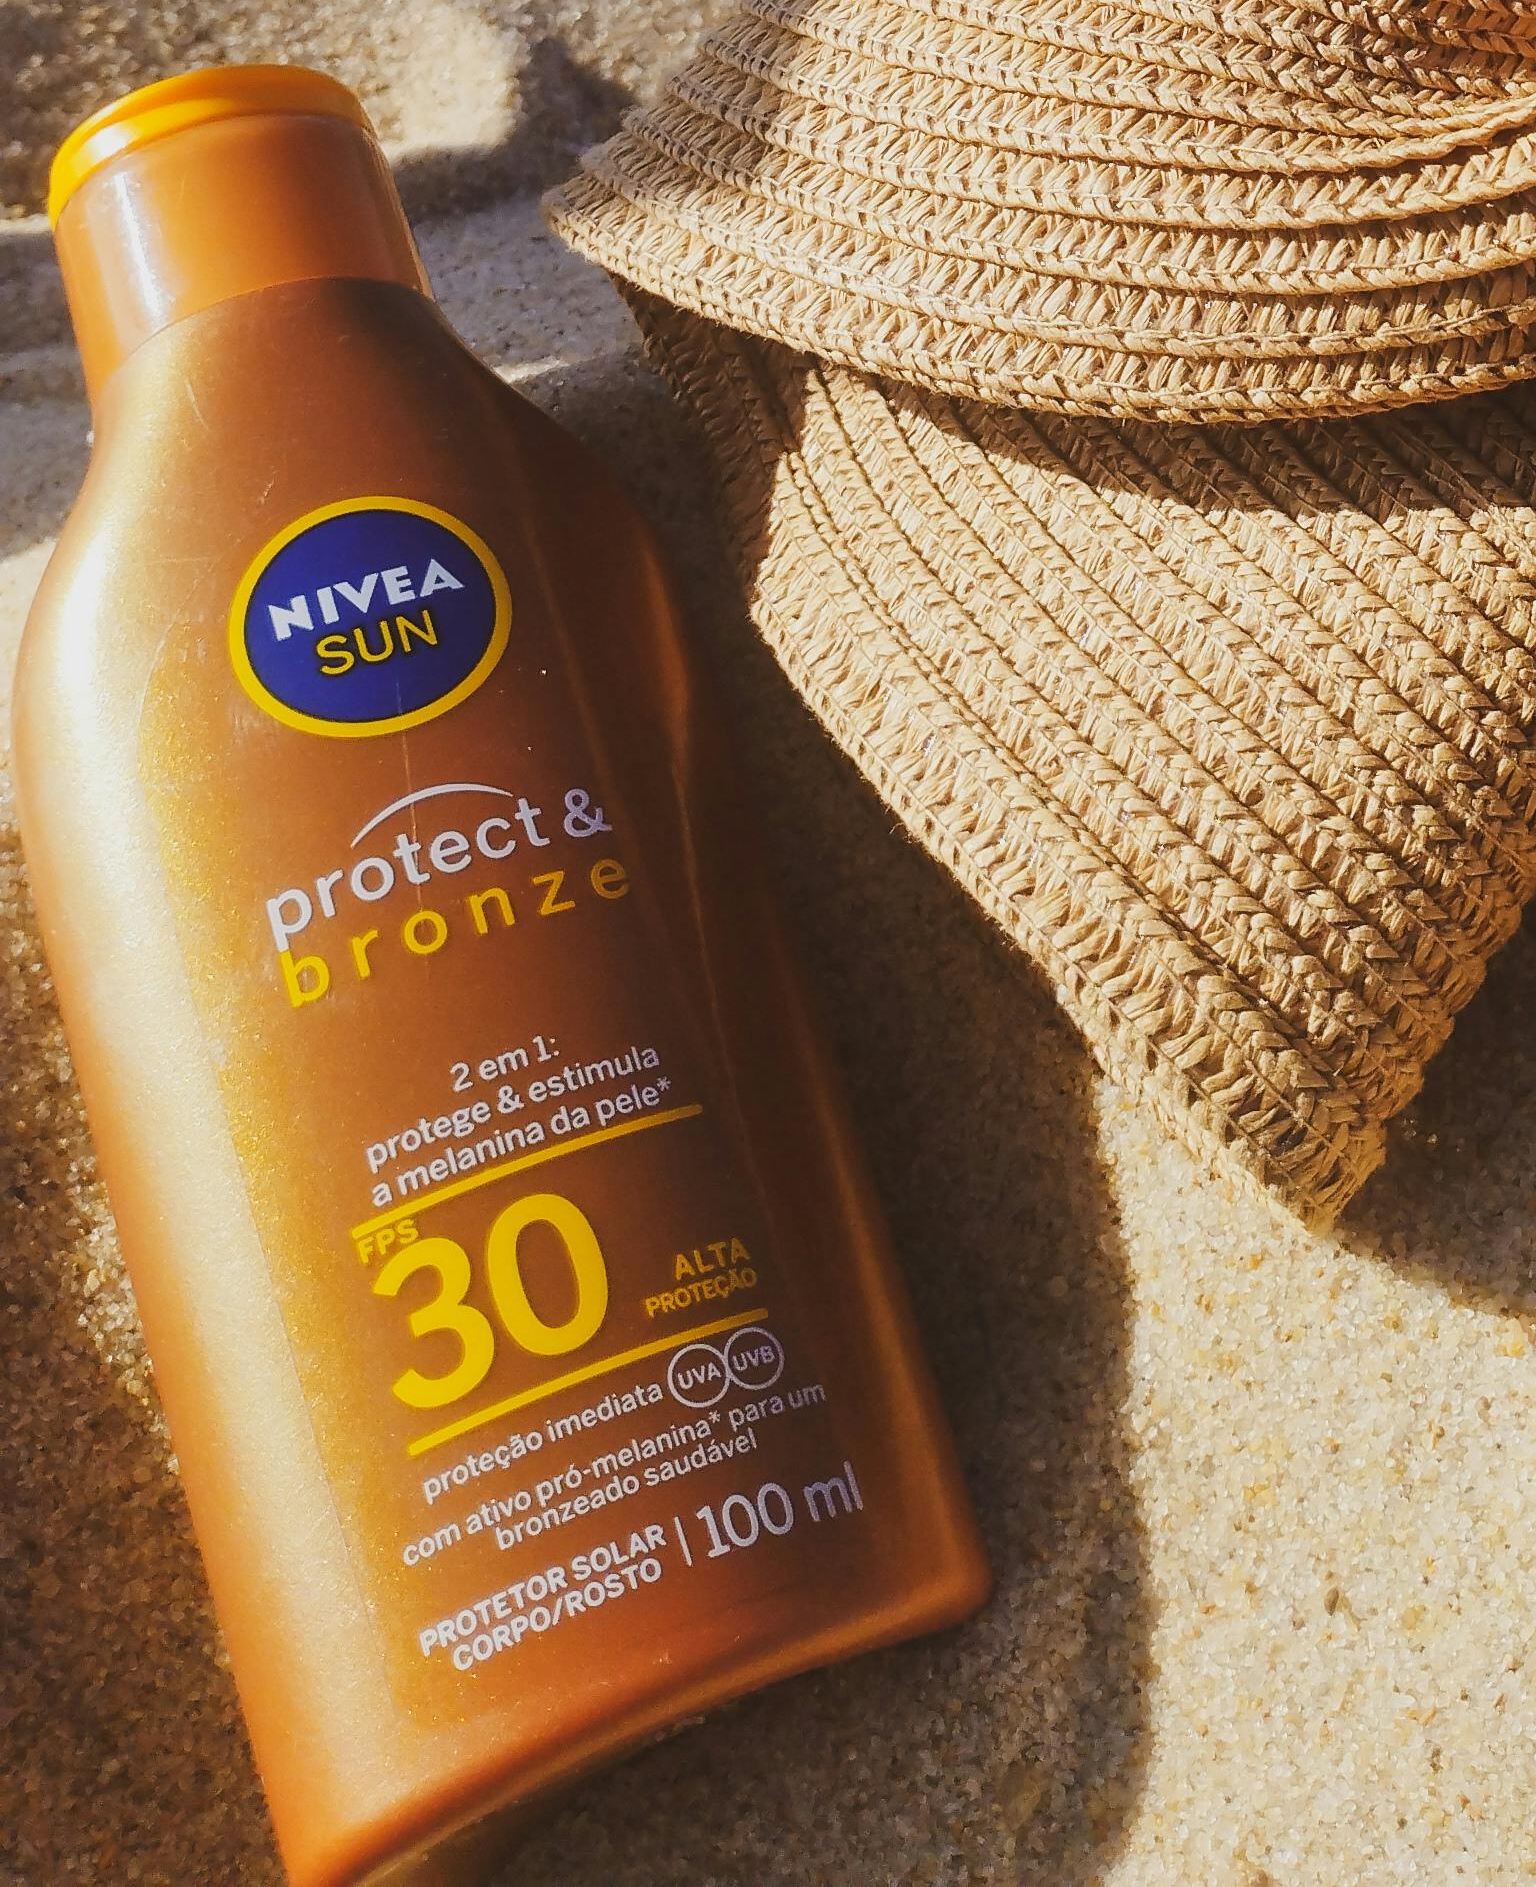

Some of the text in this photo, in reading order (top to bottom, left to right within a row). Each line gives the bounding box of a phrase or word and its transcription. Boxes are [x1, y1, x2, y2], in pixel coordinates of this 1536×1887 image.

[268, 559, 465, 641] NIVEA
[316, 609, 439, 675] SUN
[266, 788, 613, 952] protect &
[279, 859, 630, 1009] bronze
[366, 1045, 660, 1173] protege & estimula
[450, 1063, 473, 1093] 2
[479, 1047, 529, 1083] em
[372, 1182, 393, 1207] a
[398, 1121, 546, 1196] melanina
[550, 1105, 591, 1137] da
[355, 1219, 419, 1266] FPS
[644, 1262, 758, 1318] PROTEÇÃO
[673, 1237, 750, 1281] ALTA
[373, 1193, 608, 1409] 30
[677, 1363, 722, 1391] UVA
[732, 1345, 775, 1373] UVB
[402, 1523, 462, 1566] com
[465, 1490, 532, 1536] ativo
[728, 1394, 786, 1430] para
[791, 1383, 826, 1409] um
[423, 1382, 664, 1505] proteção imediata
[495, 1426, 757, 1551] bronzeado saudável
[695, 1461, 864, 1559] 100 ml
[420, 1523, 667, 1658] PROTETOR SOLAR
[452, 1557, 662, 1671] CORPO/ROSTO
